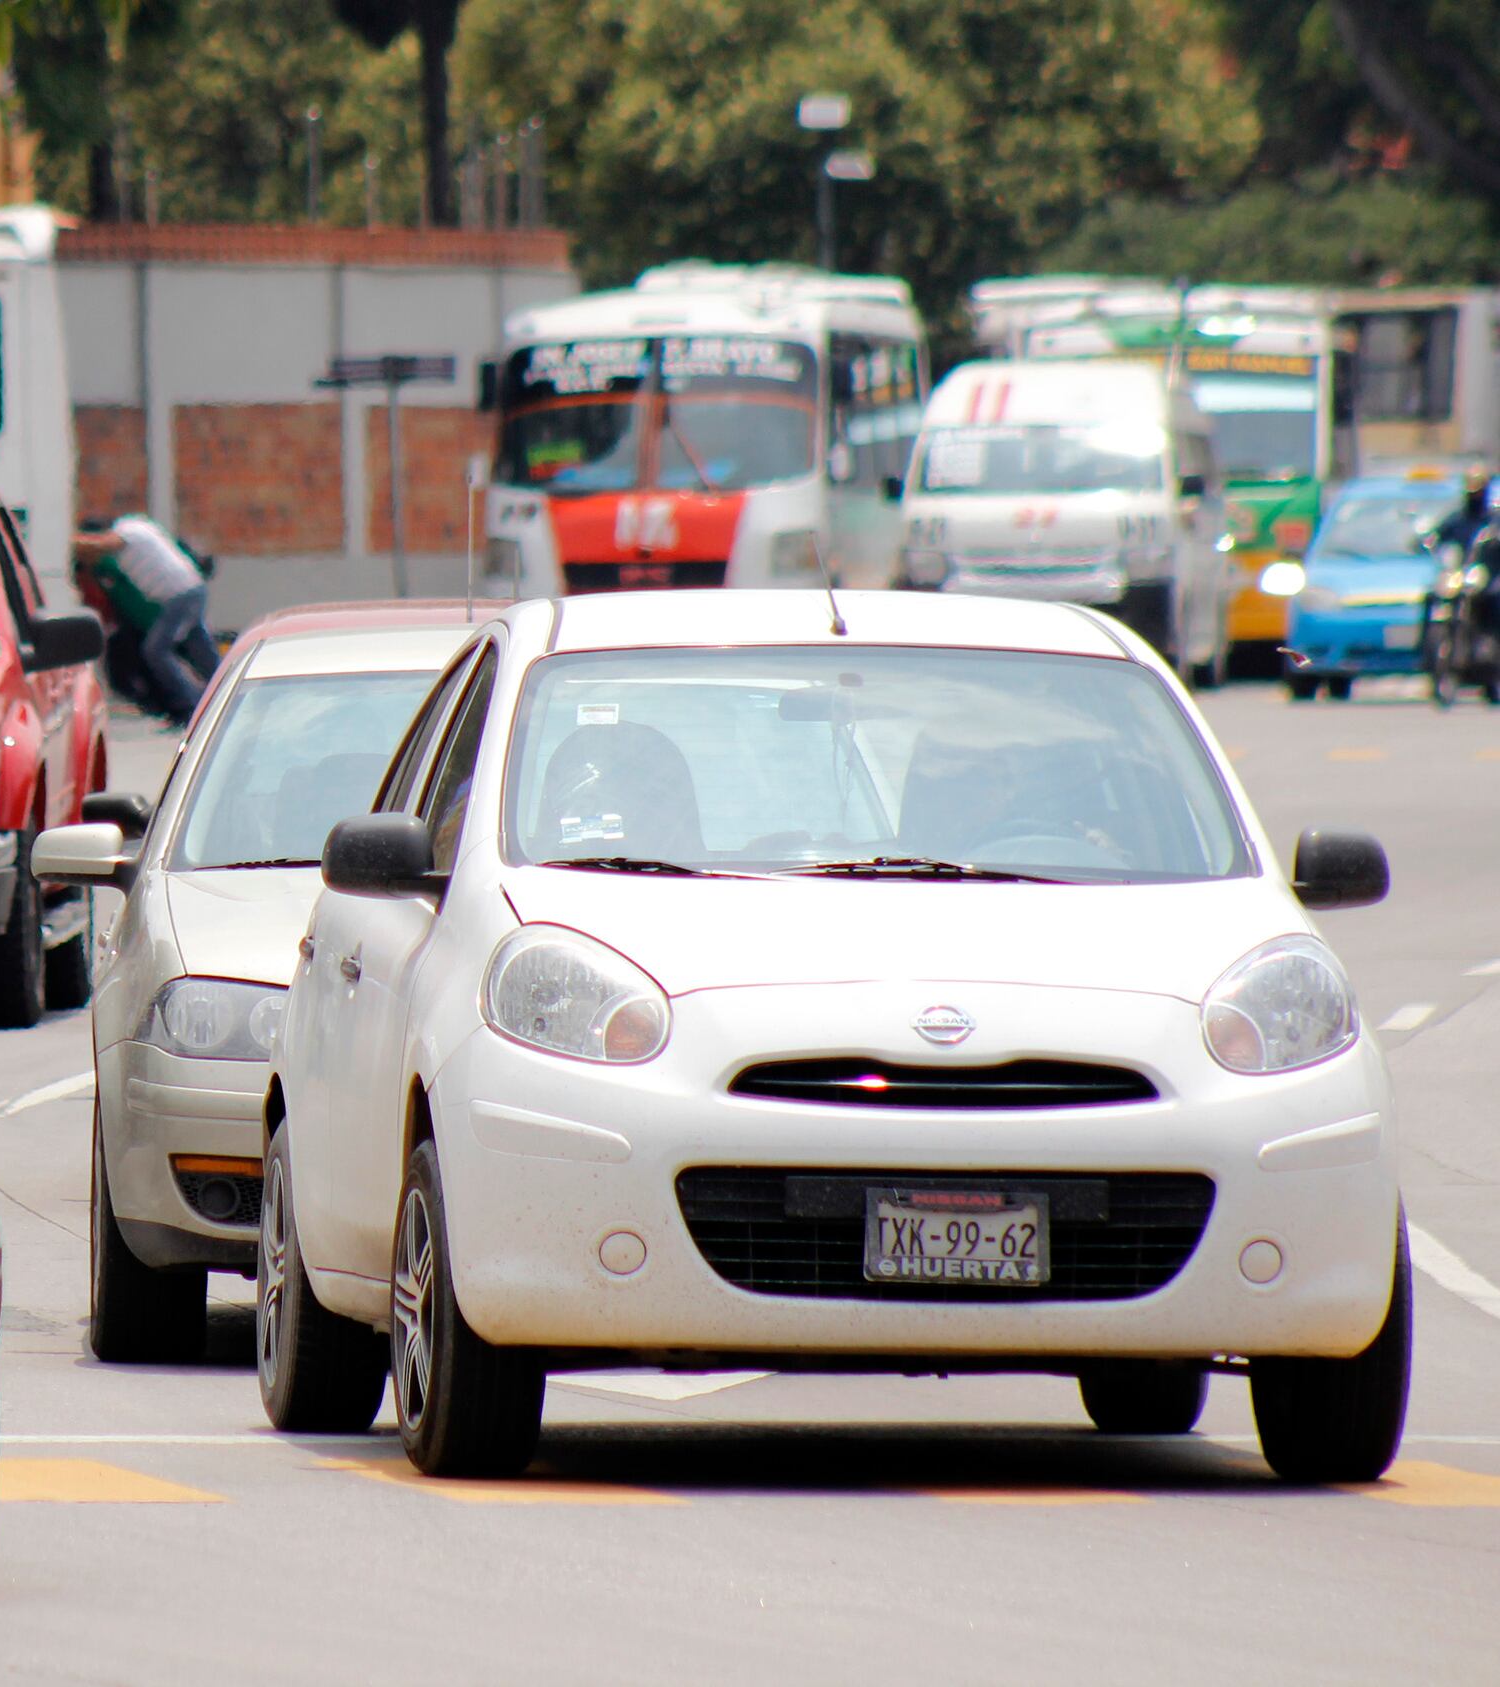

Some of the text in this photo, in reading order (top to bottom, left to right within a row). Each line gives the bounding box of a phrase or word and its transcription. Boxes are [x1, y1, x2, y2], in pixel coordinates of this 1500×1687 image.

[912, 1193, 1002, 1206] NISSAN
[878, 1216, 1036, 1258] TXK-99-62
[901, 1257, 1020, 1280] HUERTA
